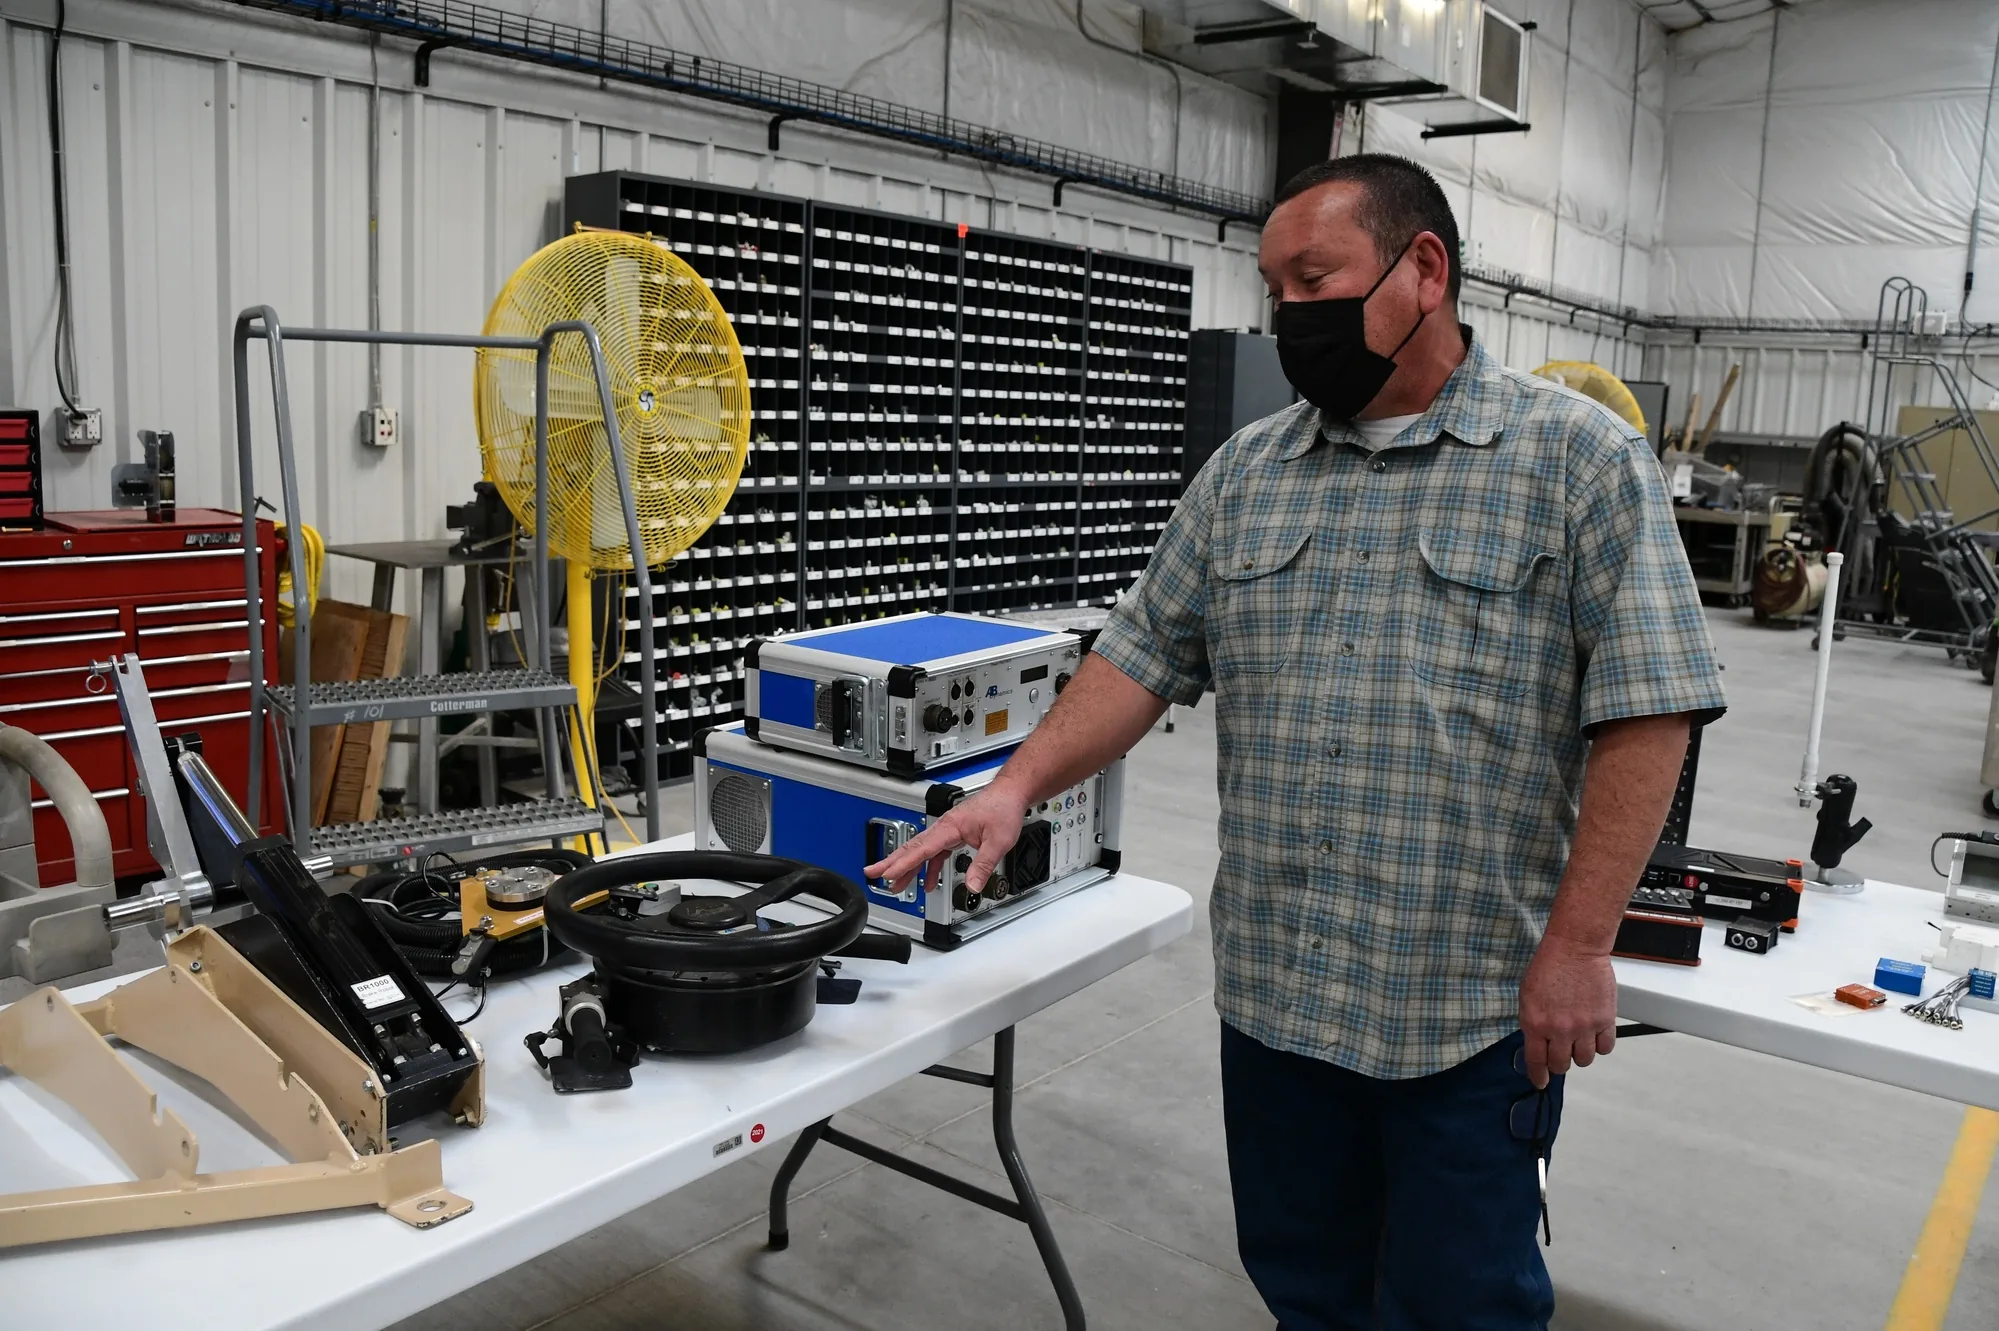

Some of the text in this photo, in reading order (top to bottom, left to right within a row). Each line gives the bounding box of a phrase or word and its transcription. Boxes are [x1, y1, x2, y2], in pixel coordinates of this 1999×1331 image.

[364, 705, 385, 719] 101
[430, 698, 488, 713] Cotterman
[357, 979, 389, 992] BR1000
